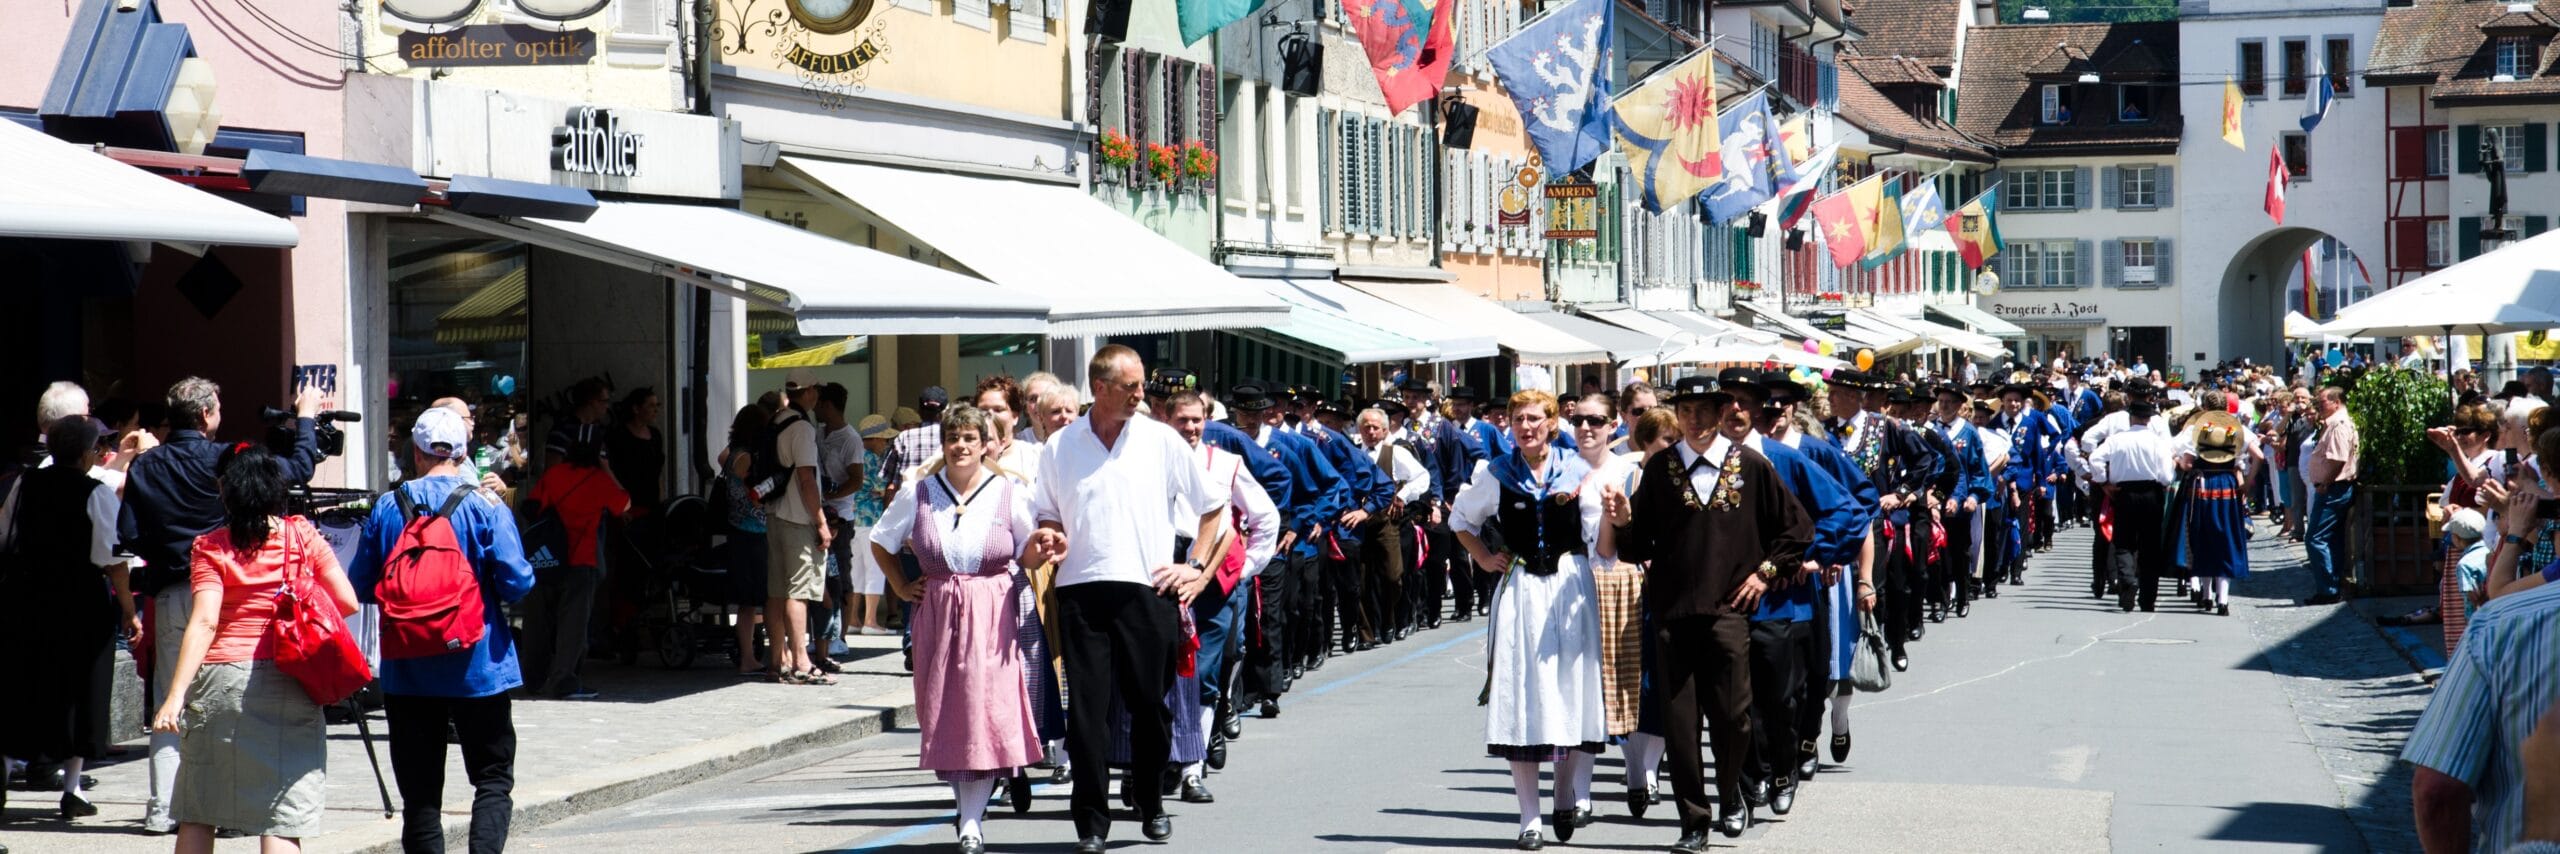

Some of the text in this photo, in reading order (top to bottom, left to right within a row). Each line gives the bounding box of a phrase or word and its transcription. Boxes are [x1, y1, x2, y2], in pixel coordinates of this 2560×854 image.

[411, 35, 585, 65] affolter optik
[786, 42, 876, 73] AFFOLTER
[563, 106, 644, 177] affolter
[1547, 187, 1594, 197] AMREIN
[1994, 302, 2098, 317] Drogerie A. Jost
[533, 559, 560, 569] didas
